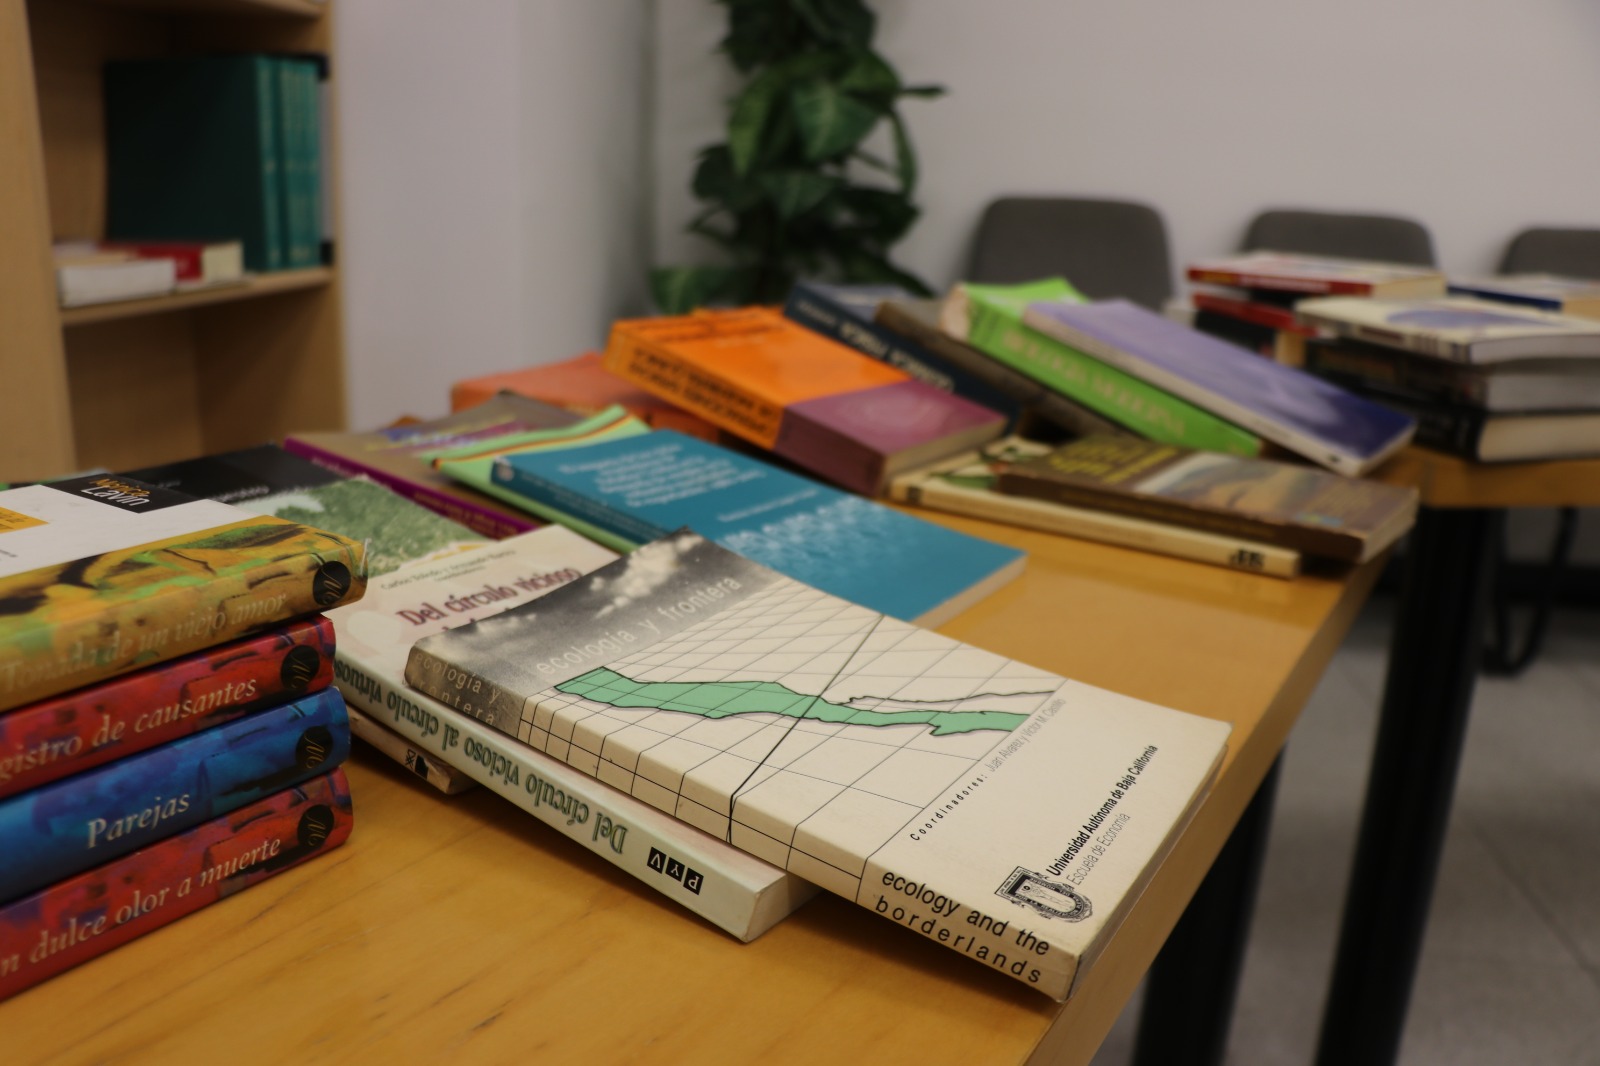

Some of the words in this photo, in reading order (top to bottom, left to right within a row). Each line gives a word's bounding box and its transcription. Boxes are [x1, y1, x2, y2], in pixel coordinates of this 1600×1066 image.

[104, 631, 134, 663] de
[138, 627, 170, 654] un
[176, 610, 226, 641] viejo
[231, 594, 287, 626] amor
[396, 602, 448, 626] Del
[638, 617, 661, 635] y
[657, 576, 743, 622] frontera
[92, 713, 126, 748] de
[134, 678, 257, 733] causantes
[386, 689, 440, 737] círculo
[488, 688, 502, 704] y
[441, 724, 459, 751] al
[463, 736, 520, 786] vicioso
[1127, 744, 1158, 776] California
[524, 774, 590, 826] círculo
[1110, 788, 1125, 800] de
[1115, 773, 1137, 791] Baja
[87, 793, 191, 849] Parejas
[592, 812, 630, 855] Del
[1082, 797, 1118, 834] Autónoma
[1046, 830, 1091, 877] Universidad
[1066, 854, 1099, 886] Escuela
[1091, 843, 1106, 856] de
[29, 916, 106, 963] dulce
[115, 886, 170, 924] olor
[177, 877, 191, 898] a
[200, 838, 281, 889] muerte
[882, 871, 960, 917] ecology
[966, 910, 1010, 937] and
[1015, 928, 1049, 956] the
[875, 895, 1041, 983] borderlands
